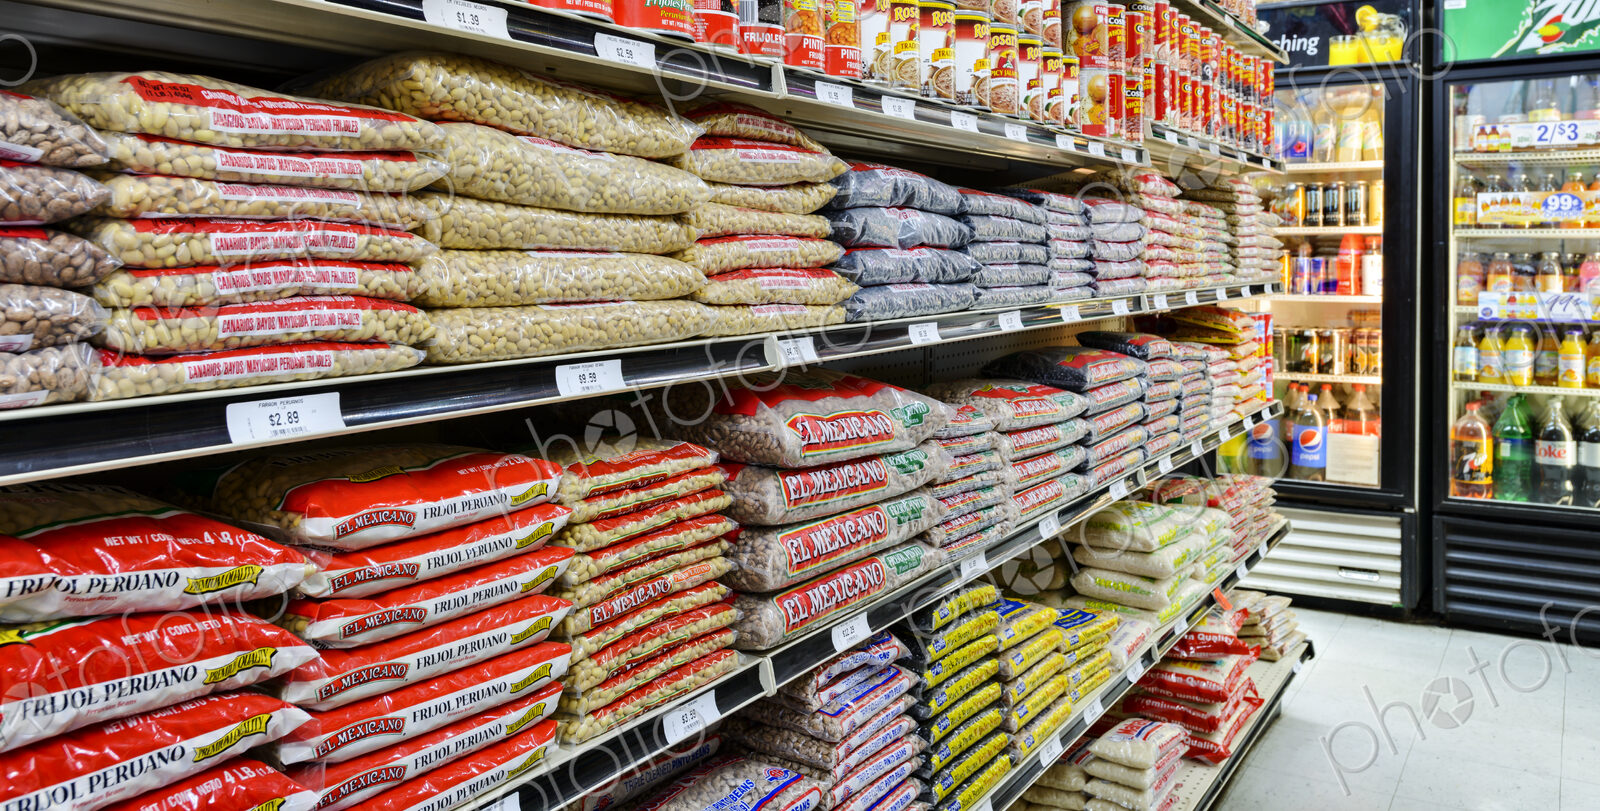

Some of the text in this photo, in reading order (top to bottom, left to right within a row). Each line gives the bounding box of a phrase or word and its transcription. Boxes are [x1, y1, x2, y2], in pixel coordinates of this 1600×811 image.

[456, 12, 480, 26] $1.39
[616, 48, 633, 59] $2.59
[579, 372, 597, 384] $9.59
[268, 410, 299, 426] $2.89
[797, 414, 893, 446] EL MEXICANO
[1300, 452, 1320, 461] pepsi
[788, 474, 809, 500] EL
[809, 458, 886, 495] MEXICANO
[424, 493, 508, 520] FRIJOL PERUANO
[338, 510, 415, 537] EL MEXICANO
[104, 536, 127, 547] NET
[127, 535, 143, 545] WT
[203, 531, 214, 544] 4
[786, 510, 886, 566] EL MEXICANO
[427, 538, 513, 570] FRIJOL PERUANO
[6, 571, 180, 598] FRIJOL PERUANO
[188, 566, 258, 594] PREMIUM QUALITY
[335, 564, 418, 591] EL MEXICANO
[434, 581, 519, 615] FRIJOL PERUANO
[593, 578, 671, 624] EL MEXICANO
[783, 562, 884, 627] EL MEXICANO
[344, 609, 426, 637] EL MEXICANO
[121, 634, 142, 646] NET
[143, 631, 161, 644] WT
[417, 633, 507, 669] FRIJOL PERUANO
[1197, 633, 1234, 645] Quality
[237, 652, 270, 675] QUALITY
[21, 665, 198, 721] FRIJOL PERUANO
[322, 665, 407, 700] EL MEXICANO
[413, 683, 507, 723] FRIJOL PERUANO
[681, 709, 696, 724] $3.59
[104, 723, 125, 736] NET
[126, 715, 143, 729] WT
[197, 715, 264, 758] PREMIUM QUALITY
[319, 718, 404, 755] EL MEXICANO
[414, 724, 502, 769] FRIJOL PERUANO
[1183, 735, 1220, 753] Quality
[89, 745, 186, 793] PERUANO
[223, 771, 234, 784] 4
[237, 766, 255, 779] LB
[321, 767, 405, 808] EL MEXICANO
[418, 771, 505, 811] FRIJOL PERUANO
[729, 779, 755, 803] BEANS
